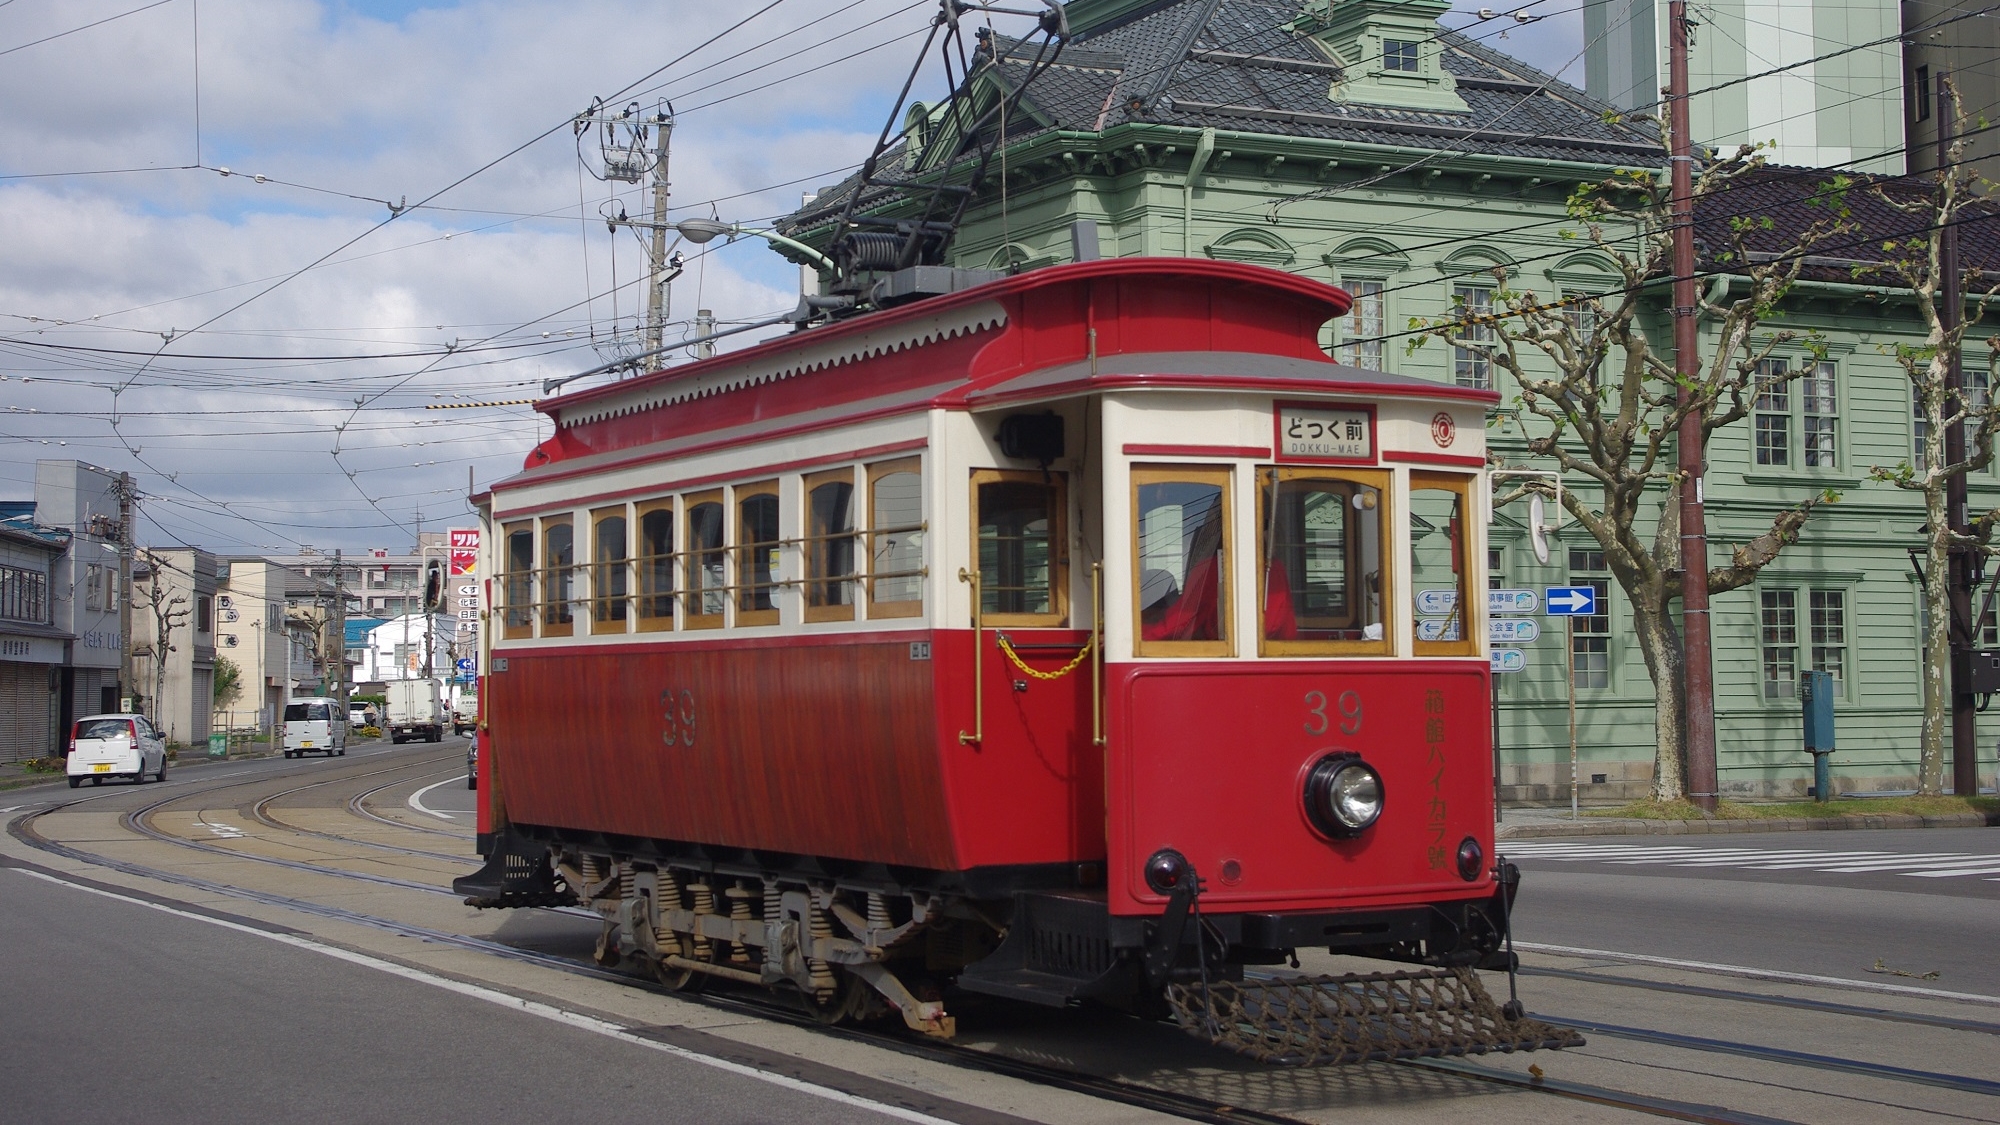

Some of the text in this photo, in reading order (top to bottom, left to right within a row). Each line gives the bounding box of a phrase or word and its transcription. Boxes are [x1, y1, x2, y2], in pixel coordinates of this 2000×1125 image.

[1288, 417, 1363, 441] どつく前
[1291, 443, 1360, 455] DOKKU-MAE
[660, 689, 696, 747] 39
[1303, 690, 1363, 736] 39
